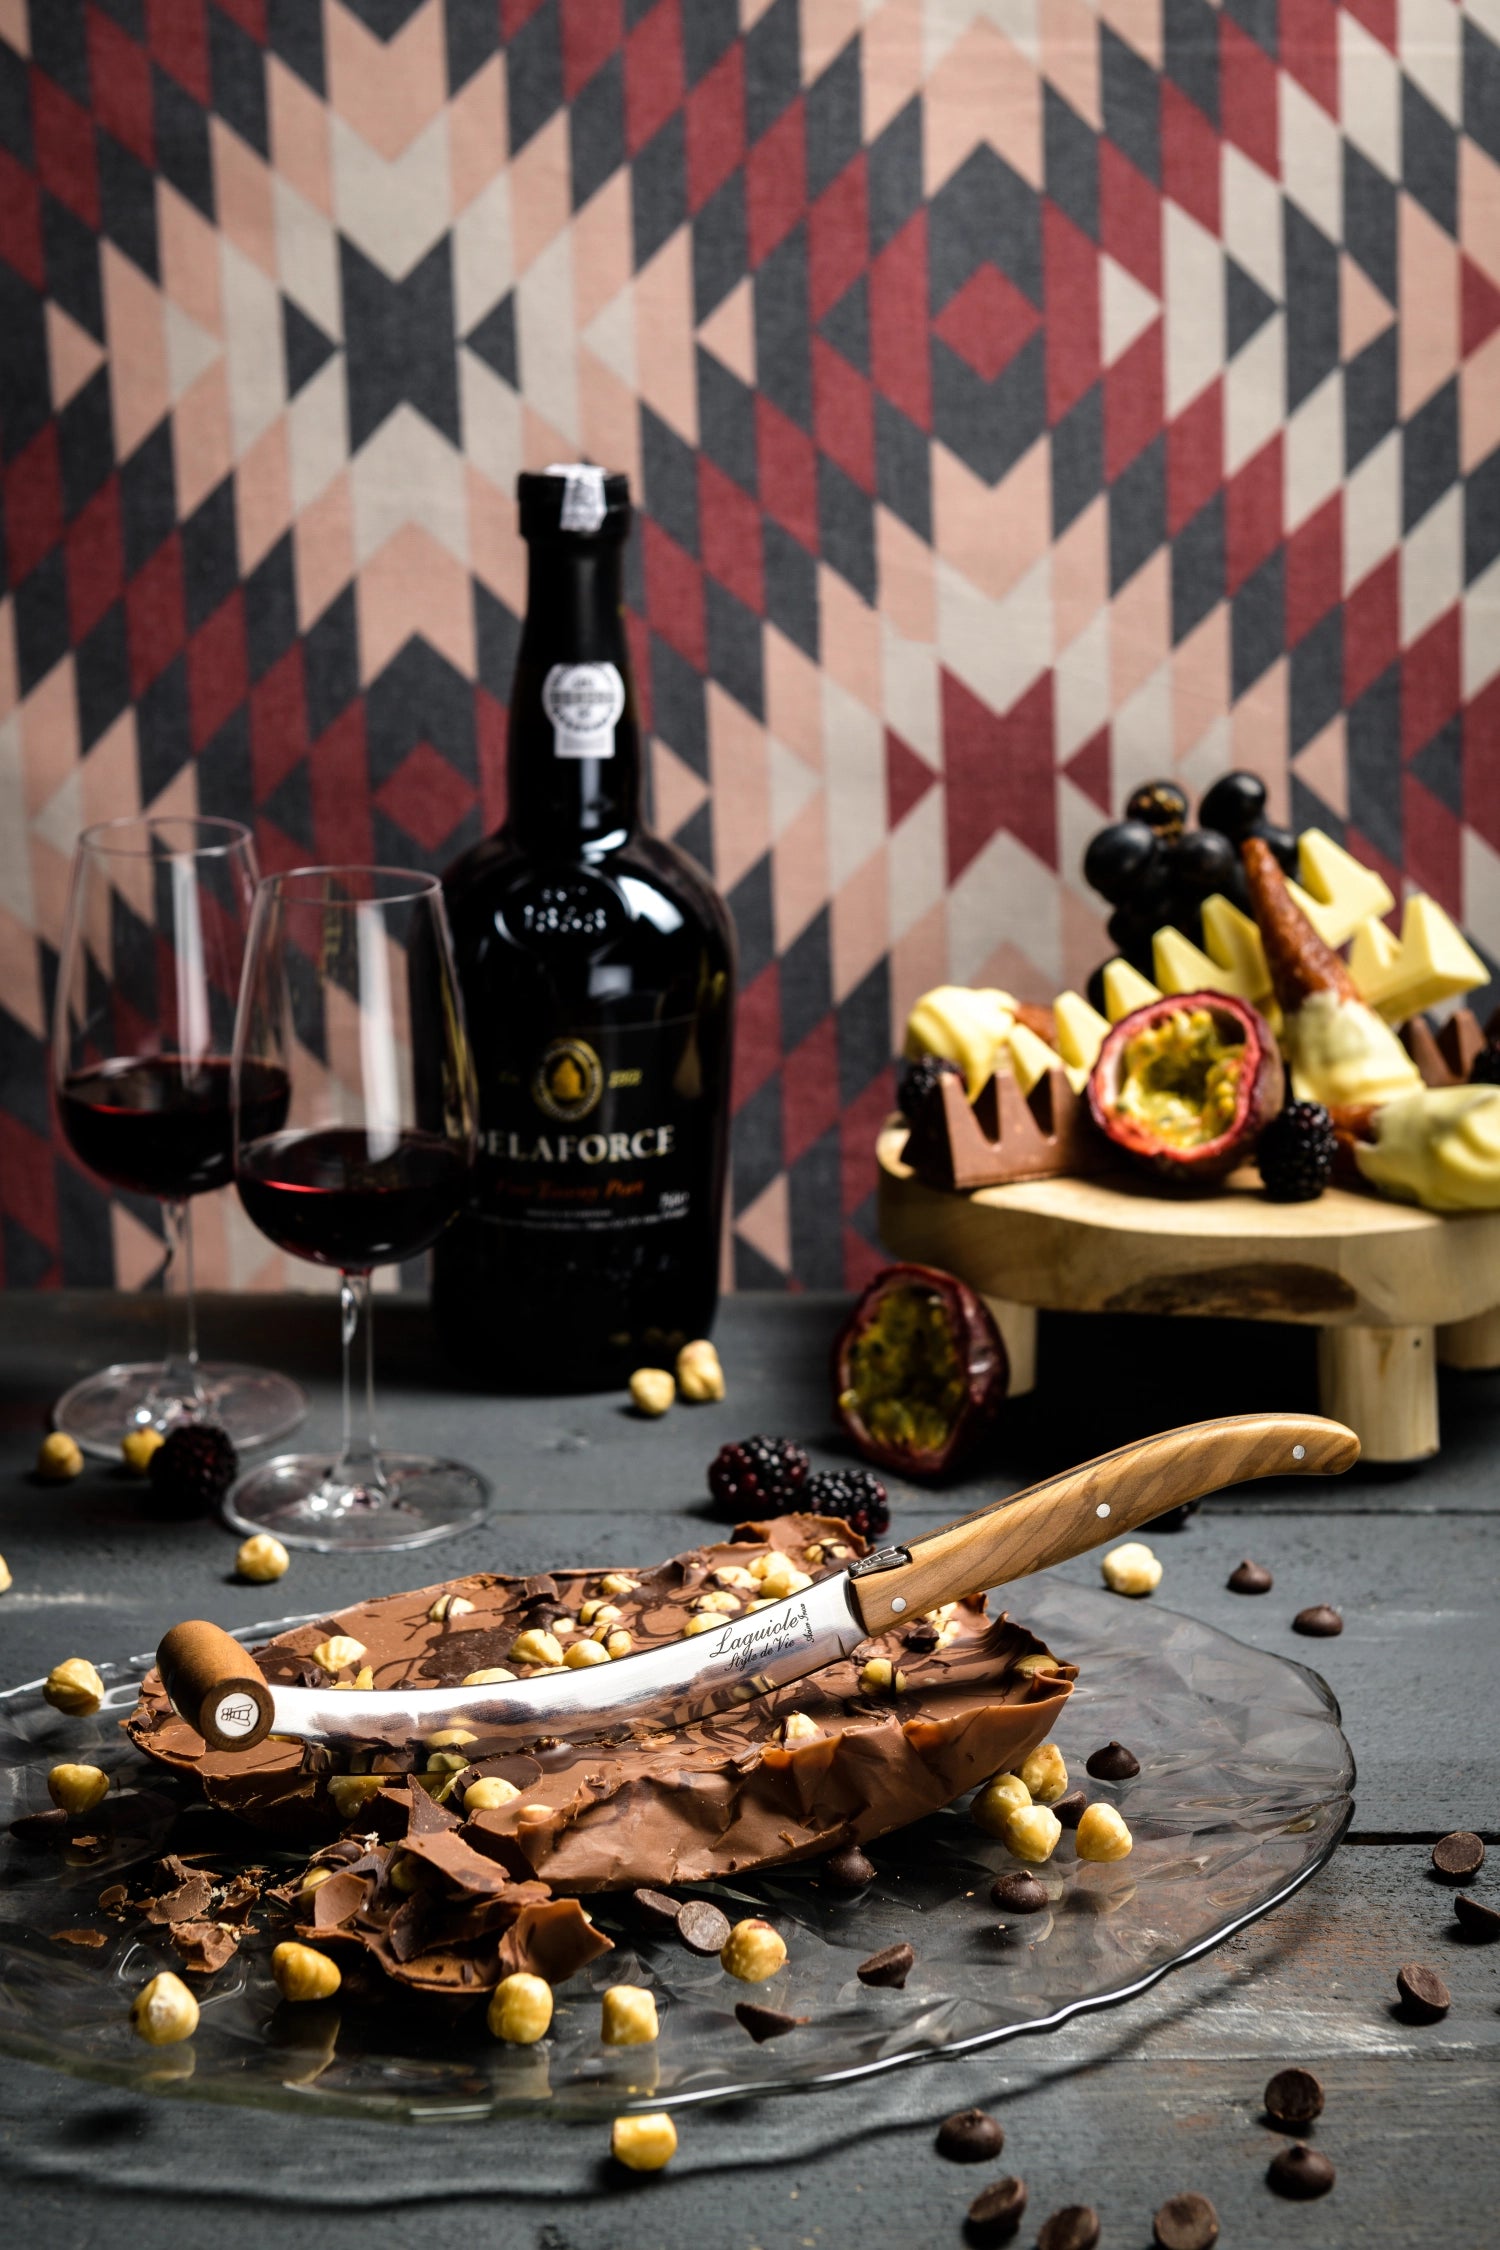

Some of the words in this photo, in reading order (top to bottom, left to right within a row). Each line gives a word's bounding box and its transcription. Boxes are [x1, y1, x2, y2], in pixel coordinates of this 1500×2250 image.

[478, 1124, 675, 1165] ELAFORCE
[709, 1607, 799, 1658] Laguiole
[724, 1649, 757, 1672] Style
[760, 1642, 773, 1659] de
[773, 1633, 795, 1652] Vie
